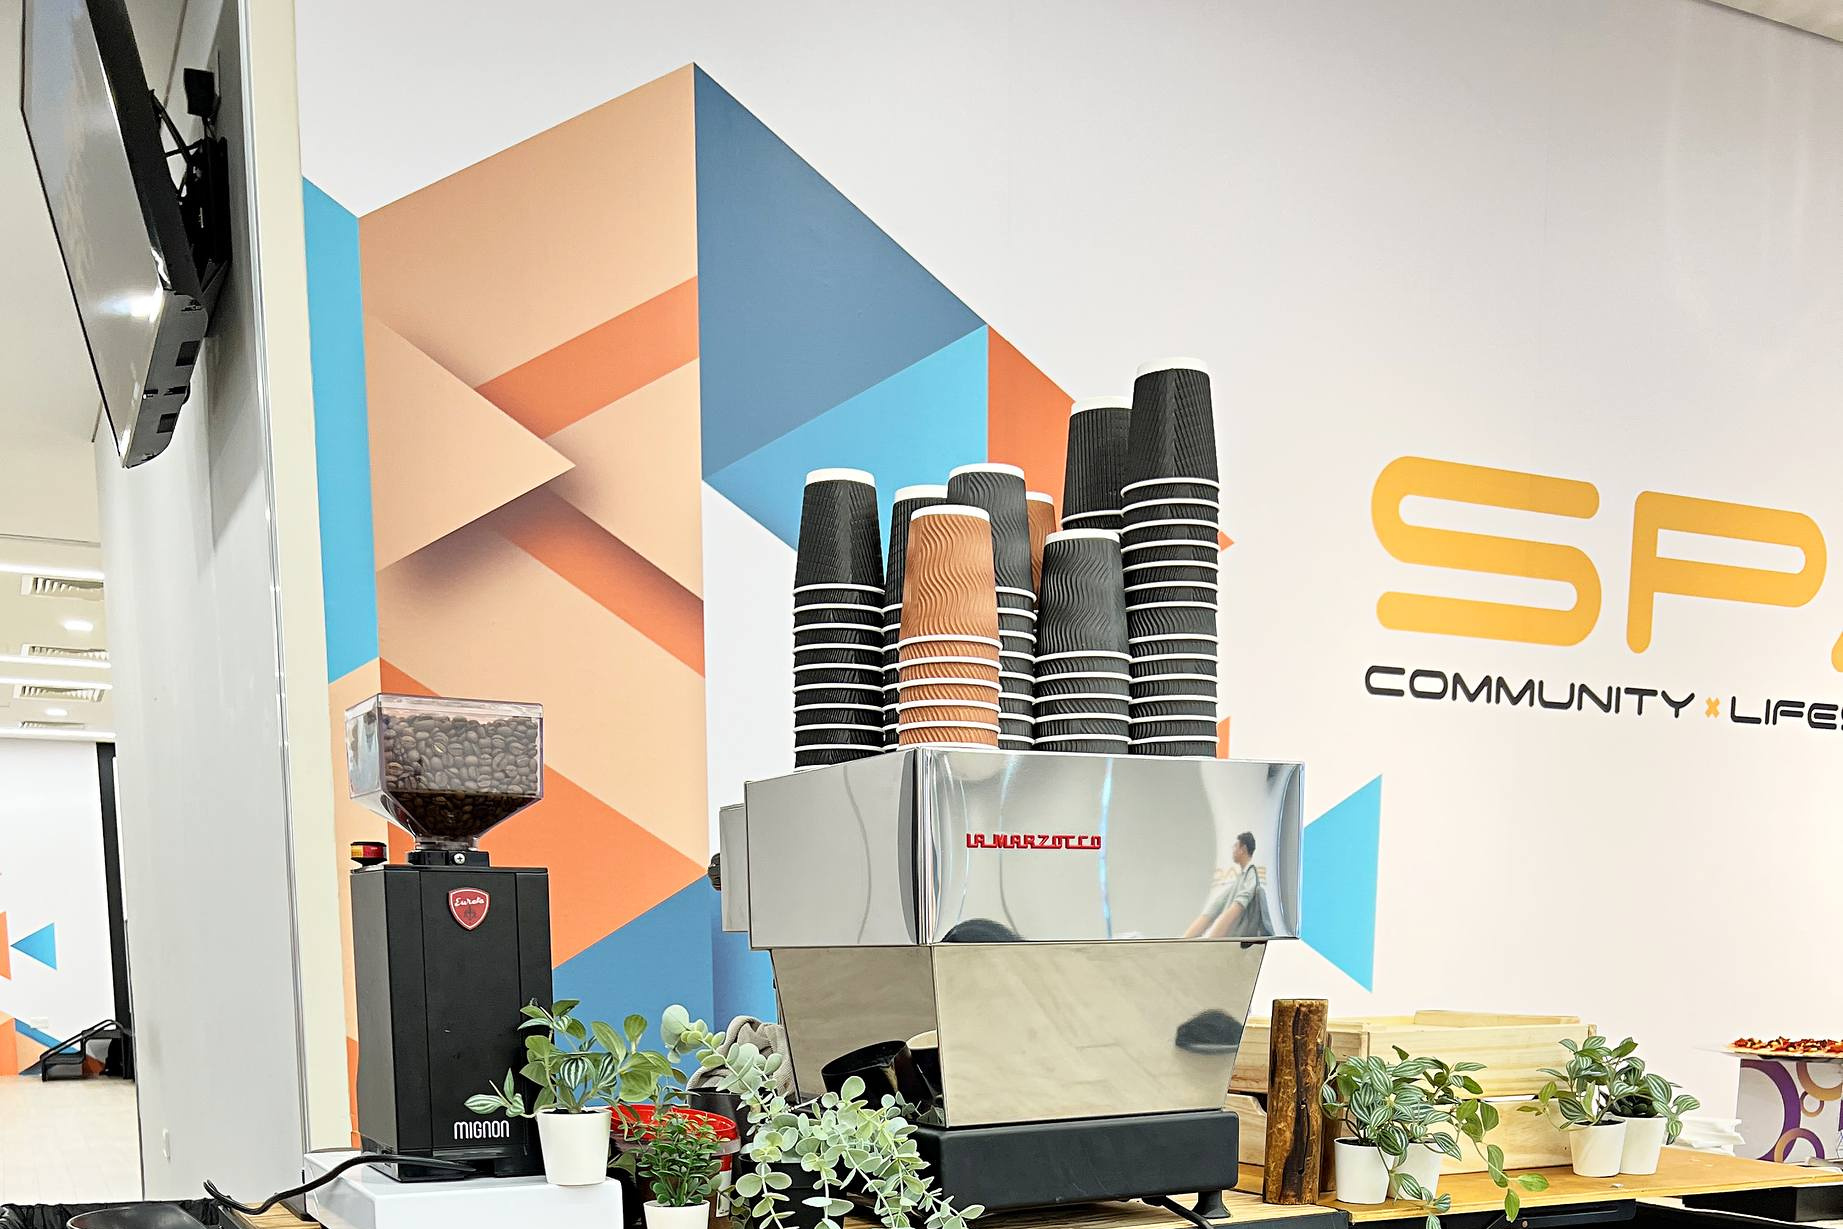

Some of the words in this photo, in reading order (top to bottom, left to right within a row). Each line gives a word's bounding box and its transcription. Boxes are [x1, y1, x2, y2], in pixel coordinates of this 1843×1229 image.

[1371, 456, 1843, 672] SP
[1365, 665, 1695, 718] COMMUNITY
[1730, 696, 1843, 731] LIFE
[966, 833, 985, 849] LA
